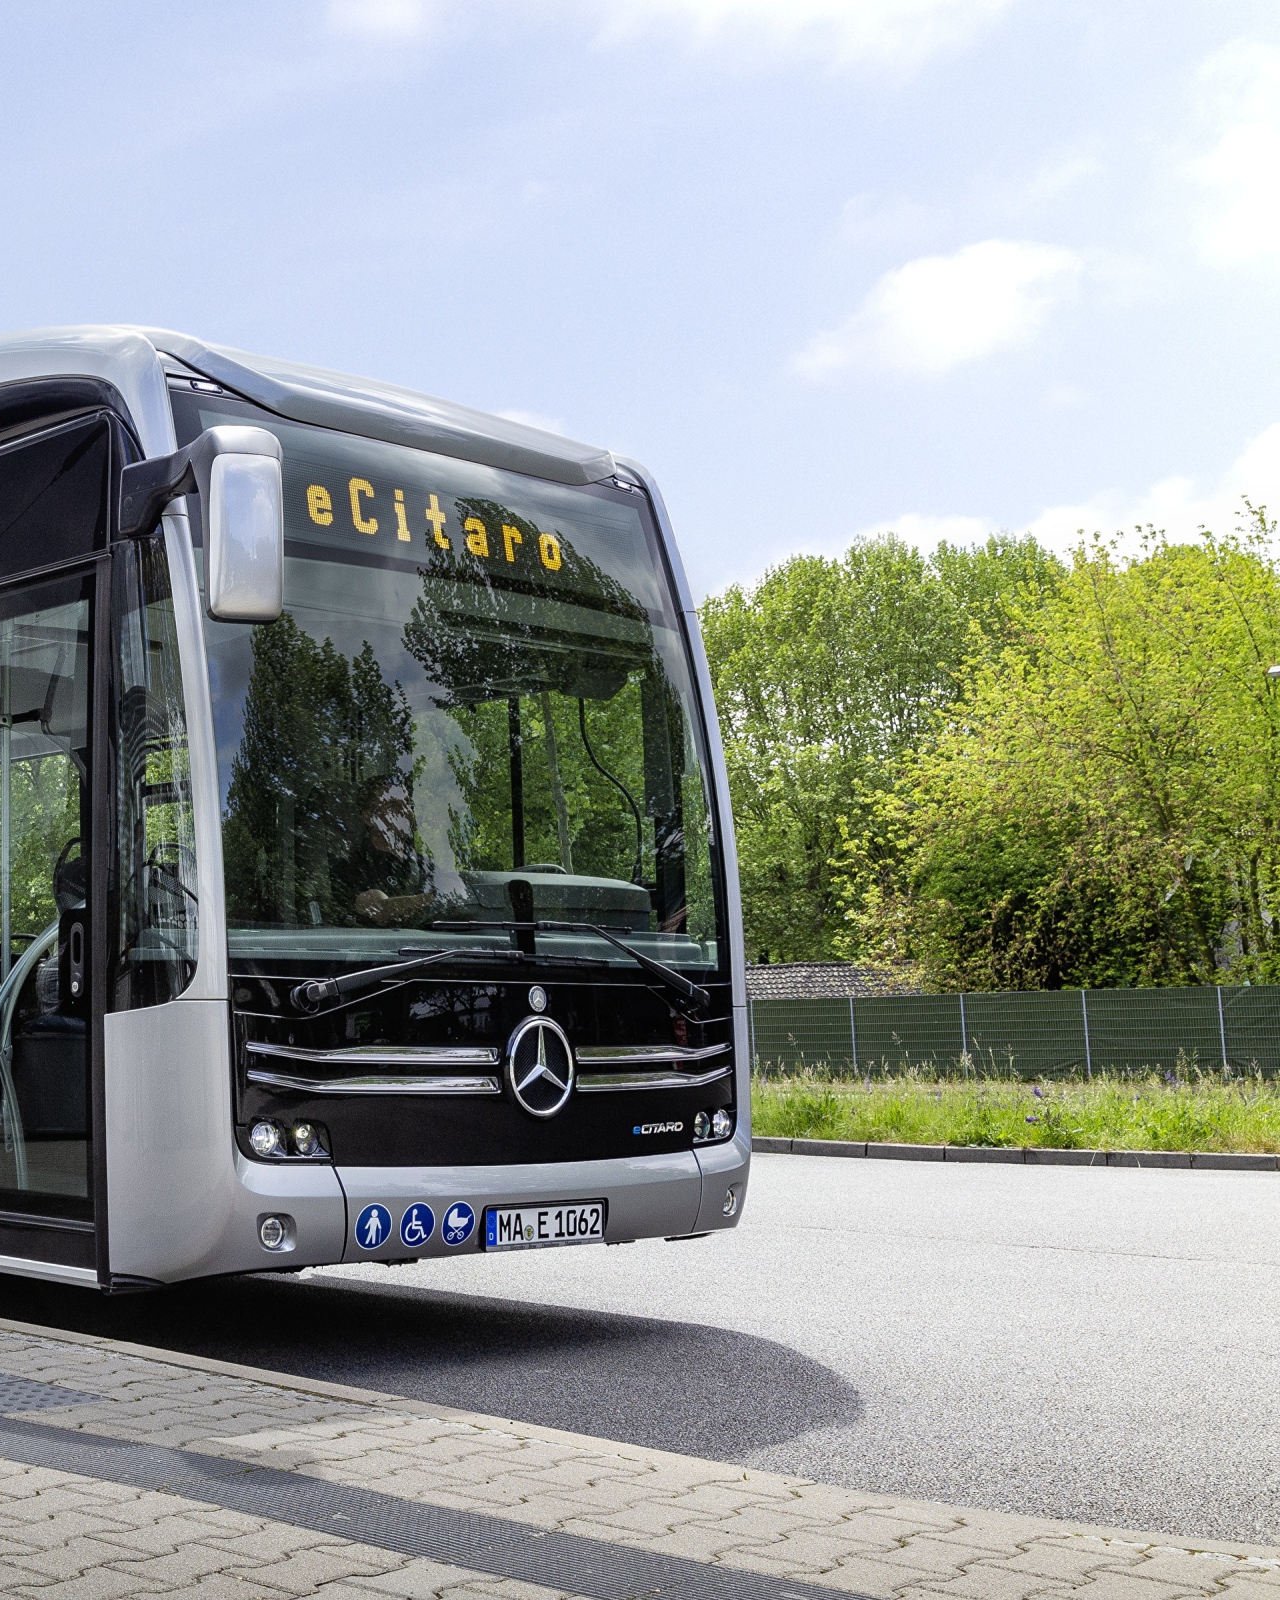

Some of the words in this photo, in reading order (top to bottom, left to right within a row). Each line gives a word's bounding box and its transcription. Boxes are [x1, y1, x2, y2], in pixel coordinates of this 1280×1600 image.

[306, 476, 563, 572] eCitaro
[499, 1213, 524, 1242] MA
[555, 1208, 600, 1238] 1062
